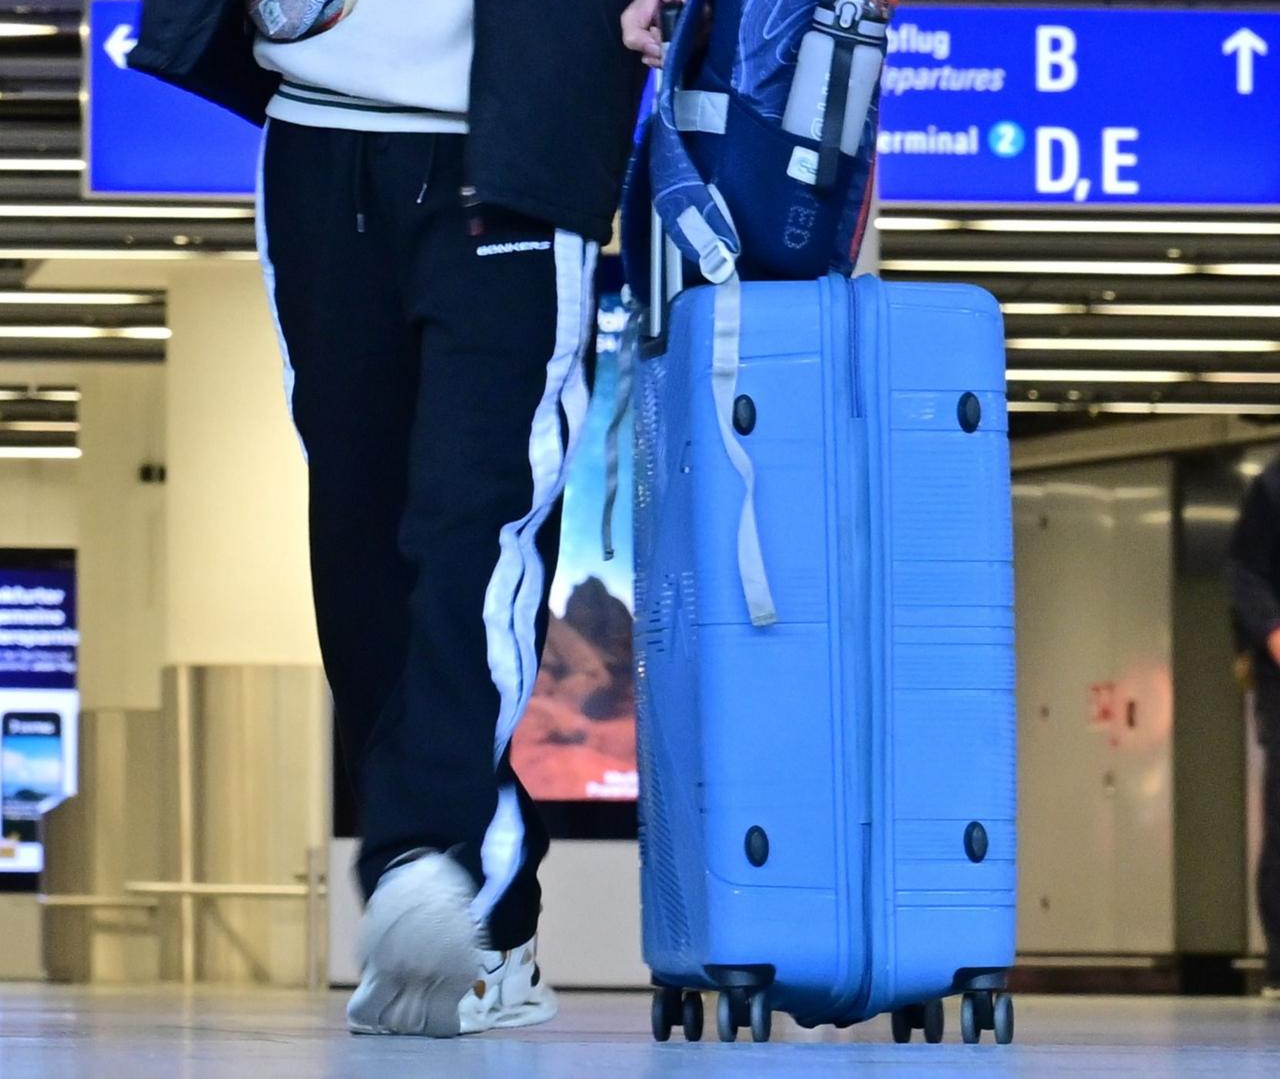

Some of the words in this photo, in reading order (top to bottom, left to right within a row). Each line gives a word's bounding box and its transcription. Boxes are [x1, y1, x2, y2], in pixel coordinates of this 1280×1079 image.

[885, 24, 951, 61] bflug
[1034, 24, 1079, 94] B
[880, 65, 1006, 96] epartures
[876, 125, 980, 156] erminal
[995, 124, 1017, 155] 2
